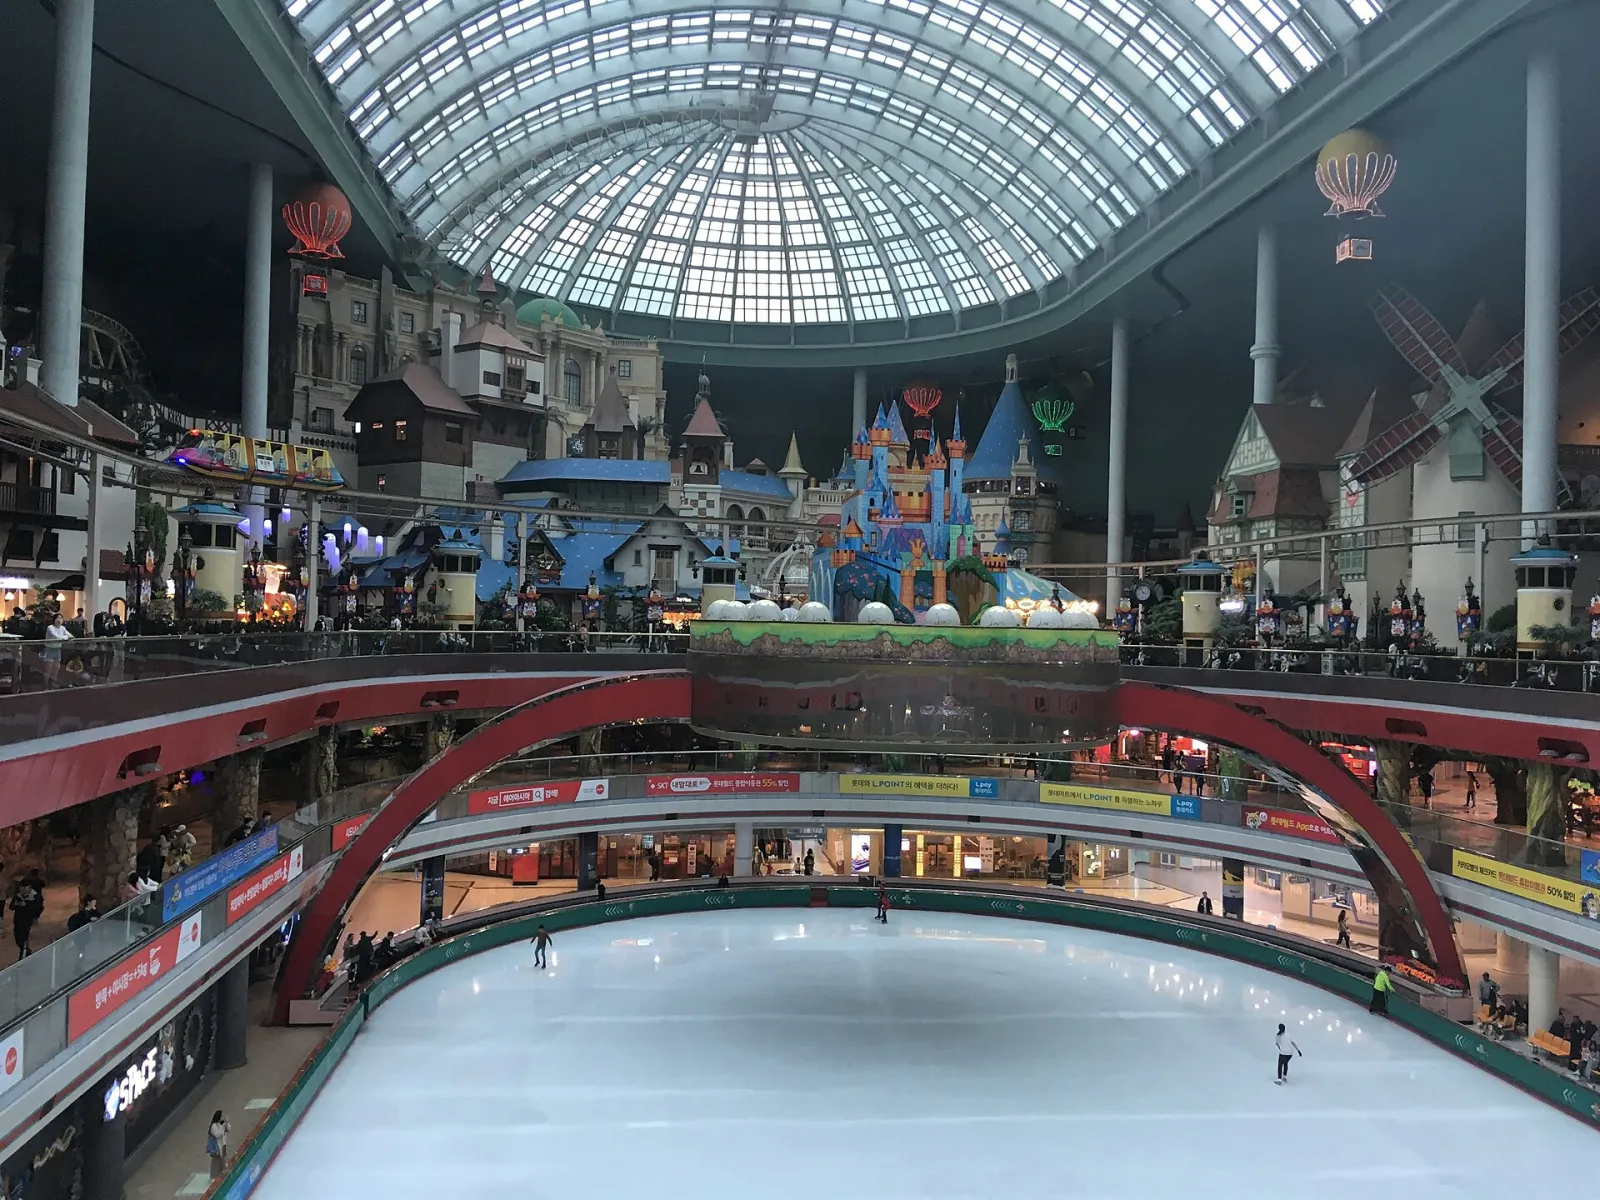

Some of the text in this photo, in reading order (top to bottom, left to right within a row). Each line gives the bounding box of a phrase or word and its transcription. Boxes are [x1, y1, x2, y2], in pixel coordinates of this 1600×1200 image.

[762, 779, 777, 787] 55%
[913, 781, 934, 790] 혜택을
[936, 782, 958, 791] 더하다!
[487, 796, 499, 805] 지금
[1048, 789, 1082, 799] 롯데마트에서
[1083, 794, 1113, 802] L.POINT
[1270, 816, 1295, 828] 롯데월드
[1546, 885, 1562, 898] 50%
[1563, 890, 1576, 902] 할인
